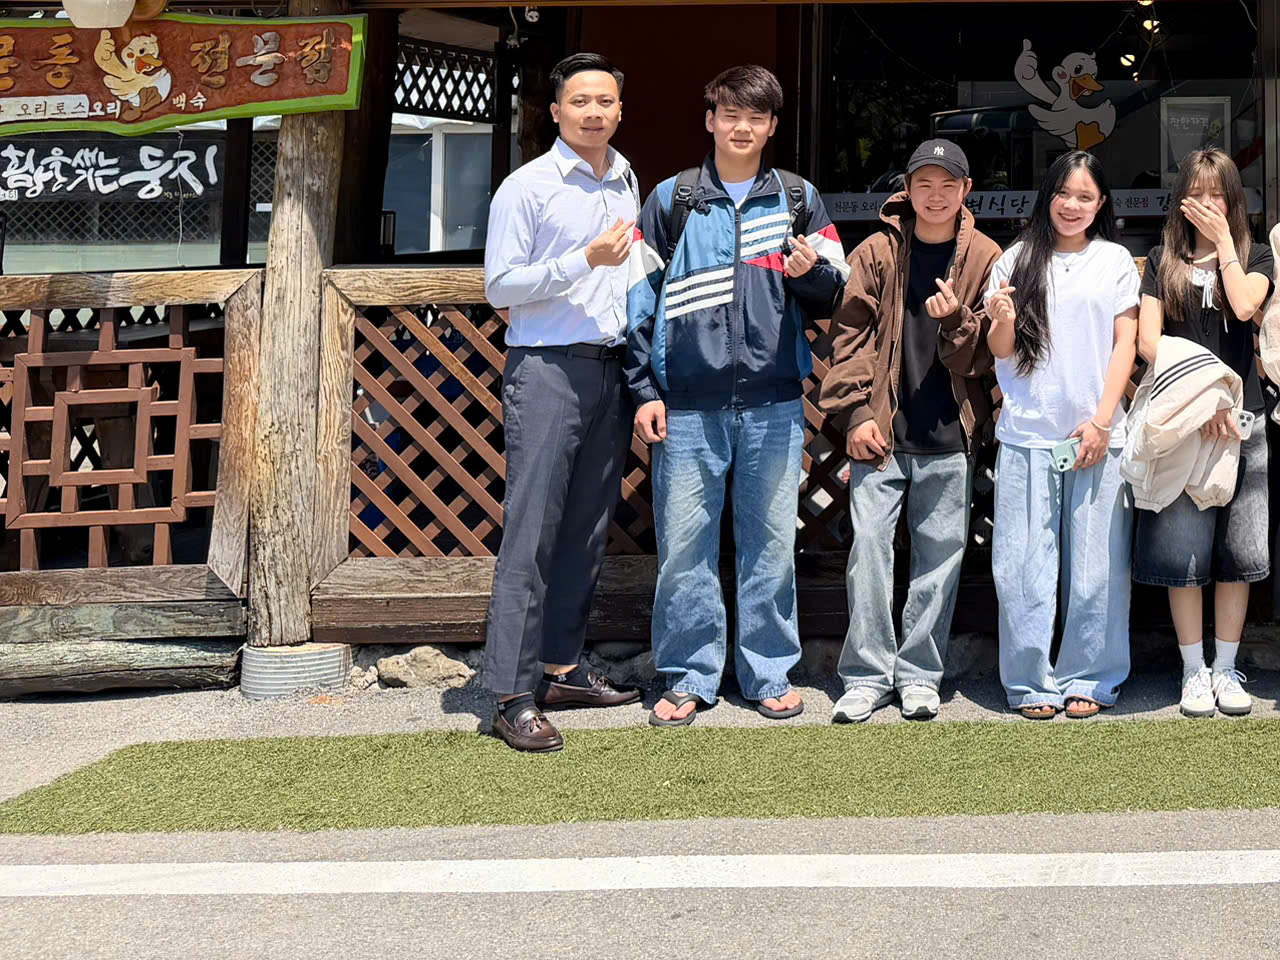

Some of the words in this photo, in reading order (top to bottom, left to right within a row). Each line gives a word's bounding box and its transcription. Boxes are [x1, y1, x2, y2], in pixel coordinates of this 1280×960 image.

[190, 27, 335, 89] 전문점
[16, 100, 87, 118] 오리로스
[88, 100, 122, 119] 오리
[172, 92, 208, 110] 백숙
[118, 144, 219, 200] 둥지
[965, 194, 1030, 215] 변식당
[1124, 196, 1149, 208] 전문점
